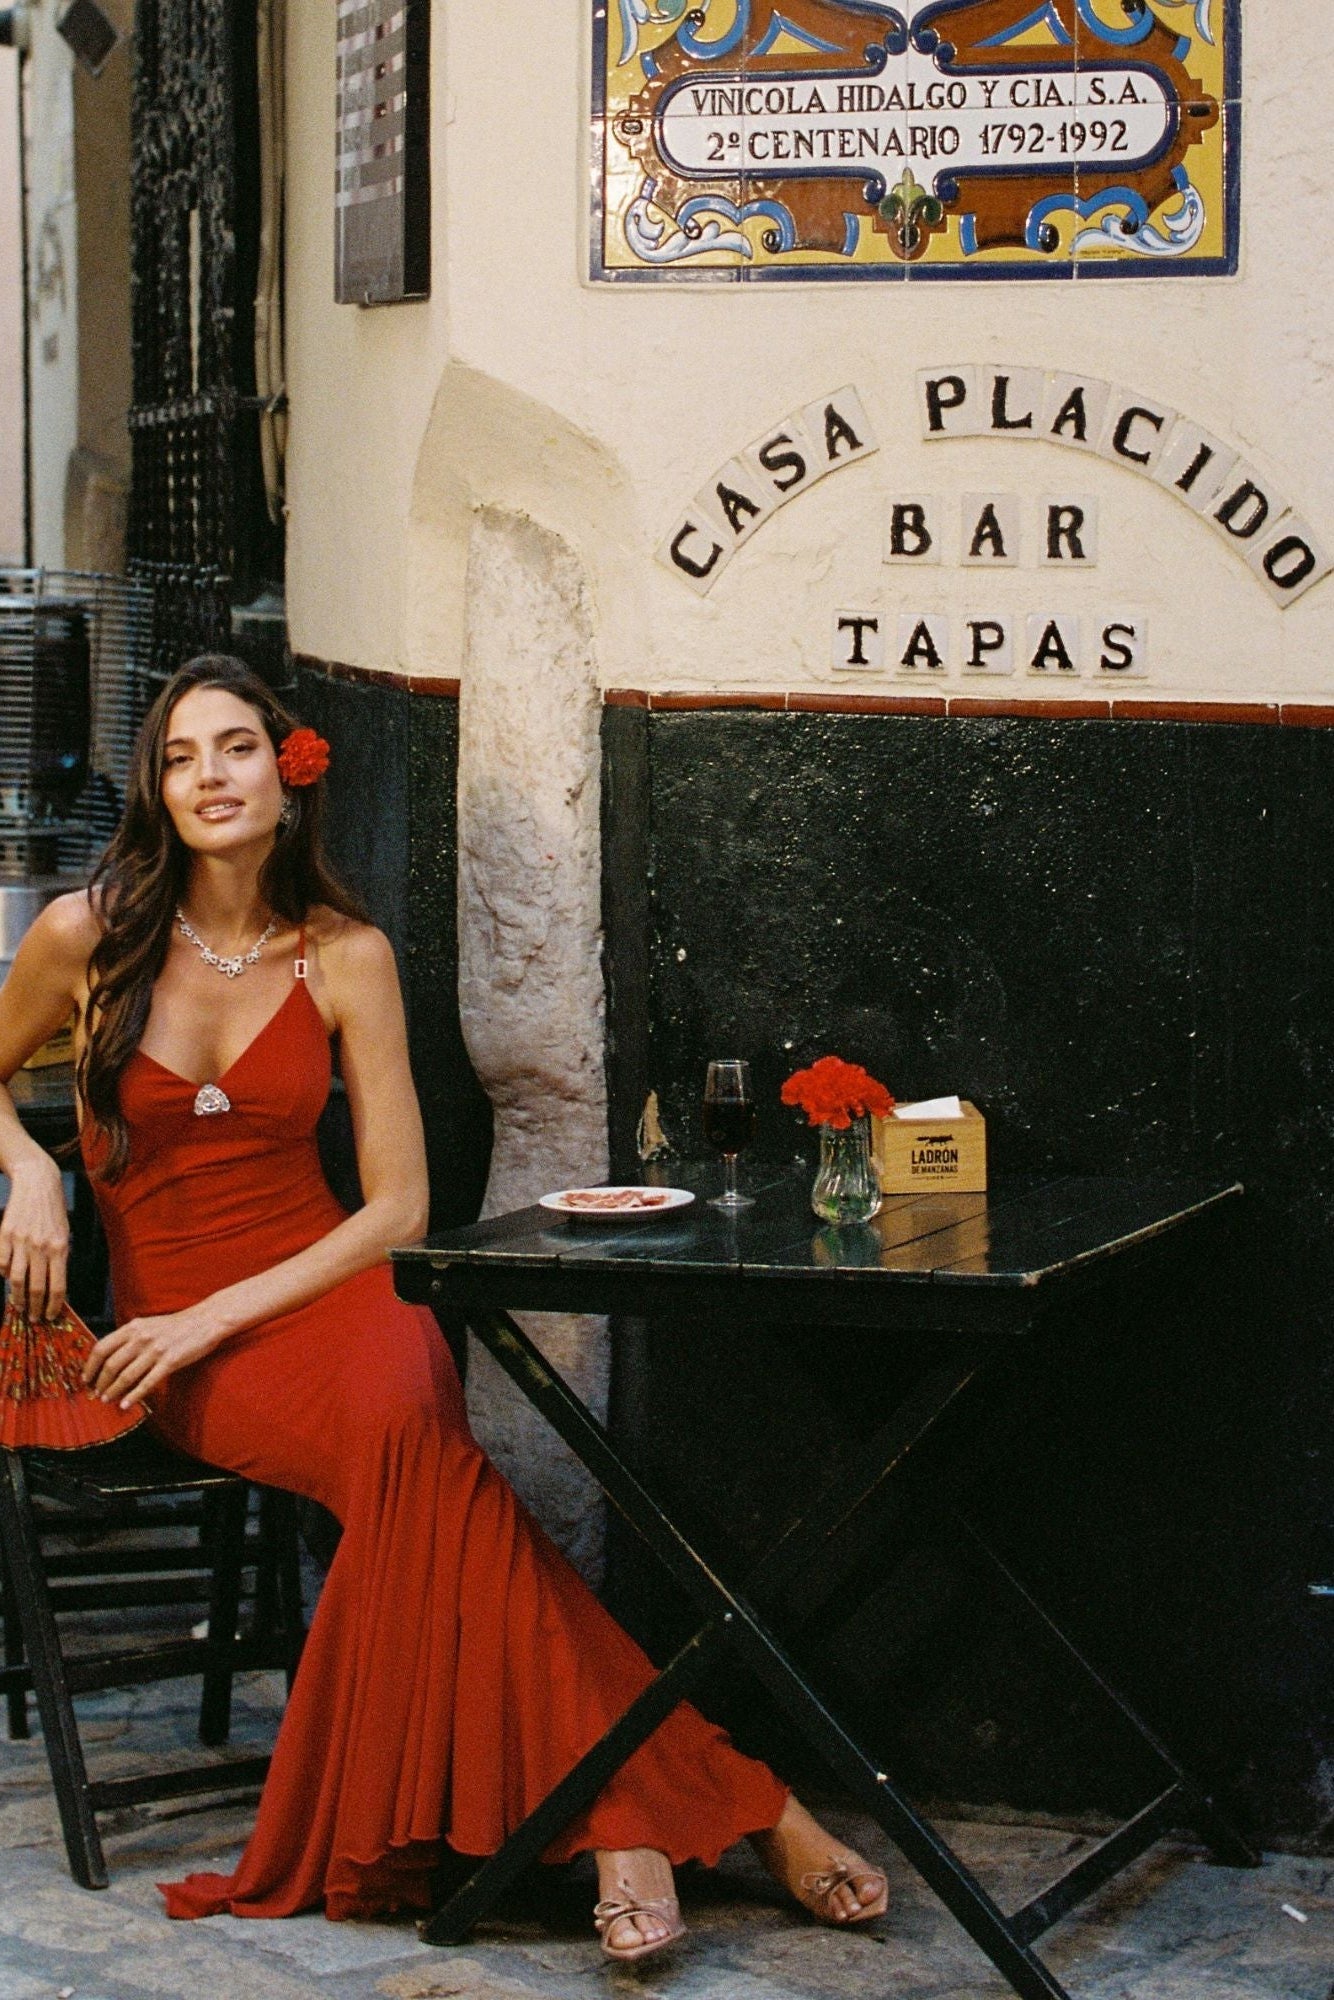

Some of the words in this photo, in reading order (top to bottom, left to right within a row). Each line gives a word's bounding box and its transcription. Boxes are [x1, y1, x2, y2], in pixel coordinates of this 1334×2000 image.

[691, 86, 828, 116] VINICOLA
[836, 81, 967, 113] HIDALGO
[979, 80, 1000, 109] Y
[1009, 79, 1074, 108] CIA.
[1087, 76, 1149, 106] S.A.
[748, 125, 961, 160] CENTENARIO
[979, 119, 1129, 155] 1792-1992
[670, 403, 864, 579] CASA
[925, 375, 1316, 590] PLACIDO
[890, 503, 1086, 559] BAR
[837, 617, 1135, 672] TAPAS
[911, 1165, 920, 1174] DE
[921, 1165, 958, 1173] MANZANAS
